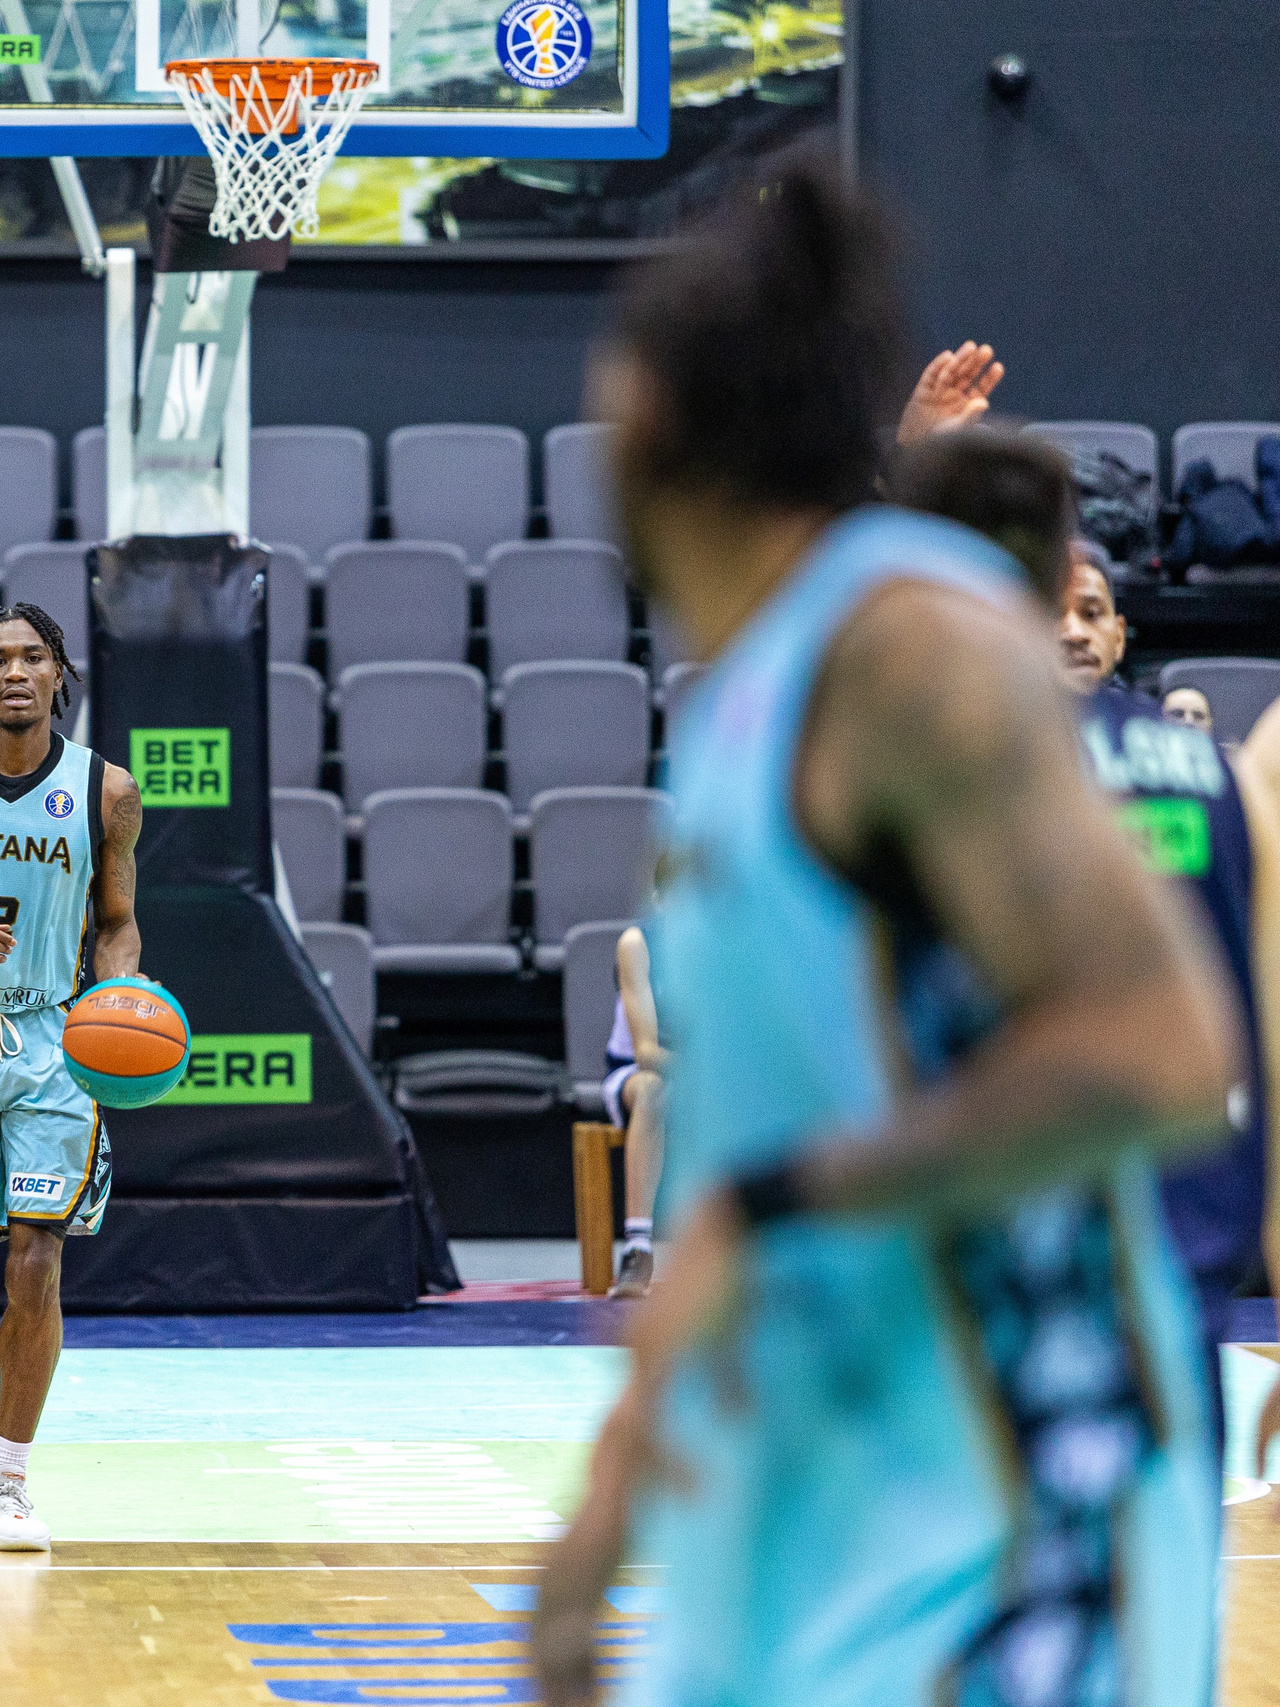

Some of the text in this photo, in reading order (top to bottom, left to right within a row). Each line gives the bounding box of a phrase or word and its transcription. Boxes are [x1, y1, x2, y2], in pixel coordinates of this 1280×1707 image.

[519, 75, 554, 88] UNITED
[555, 56, 587, 86] LEAGUE
[145, 741, 219, 764] BET
